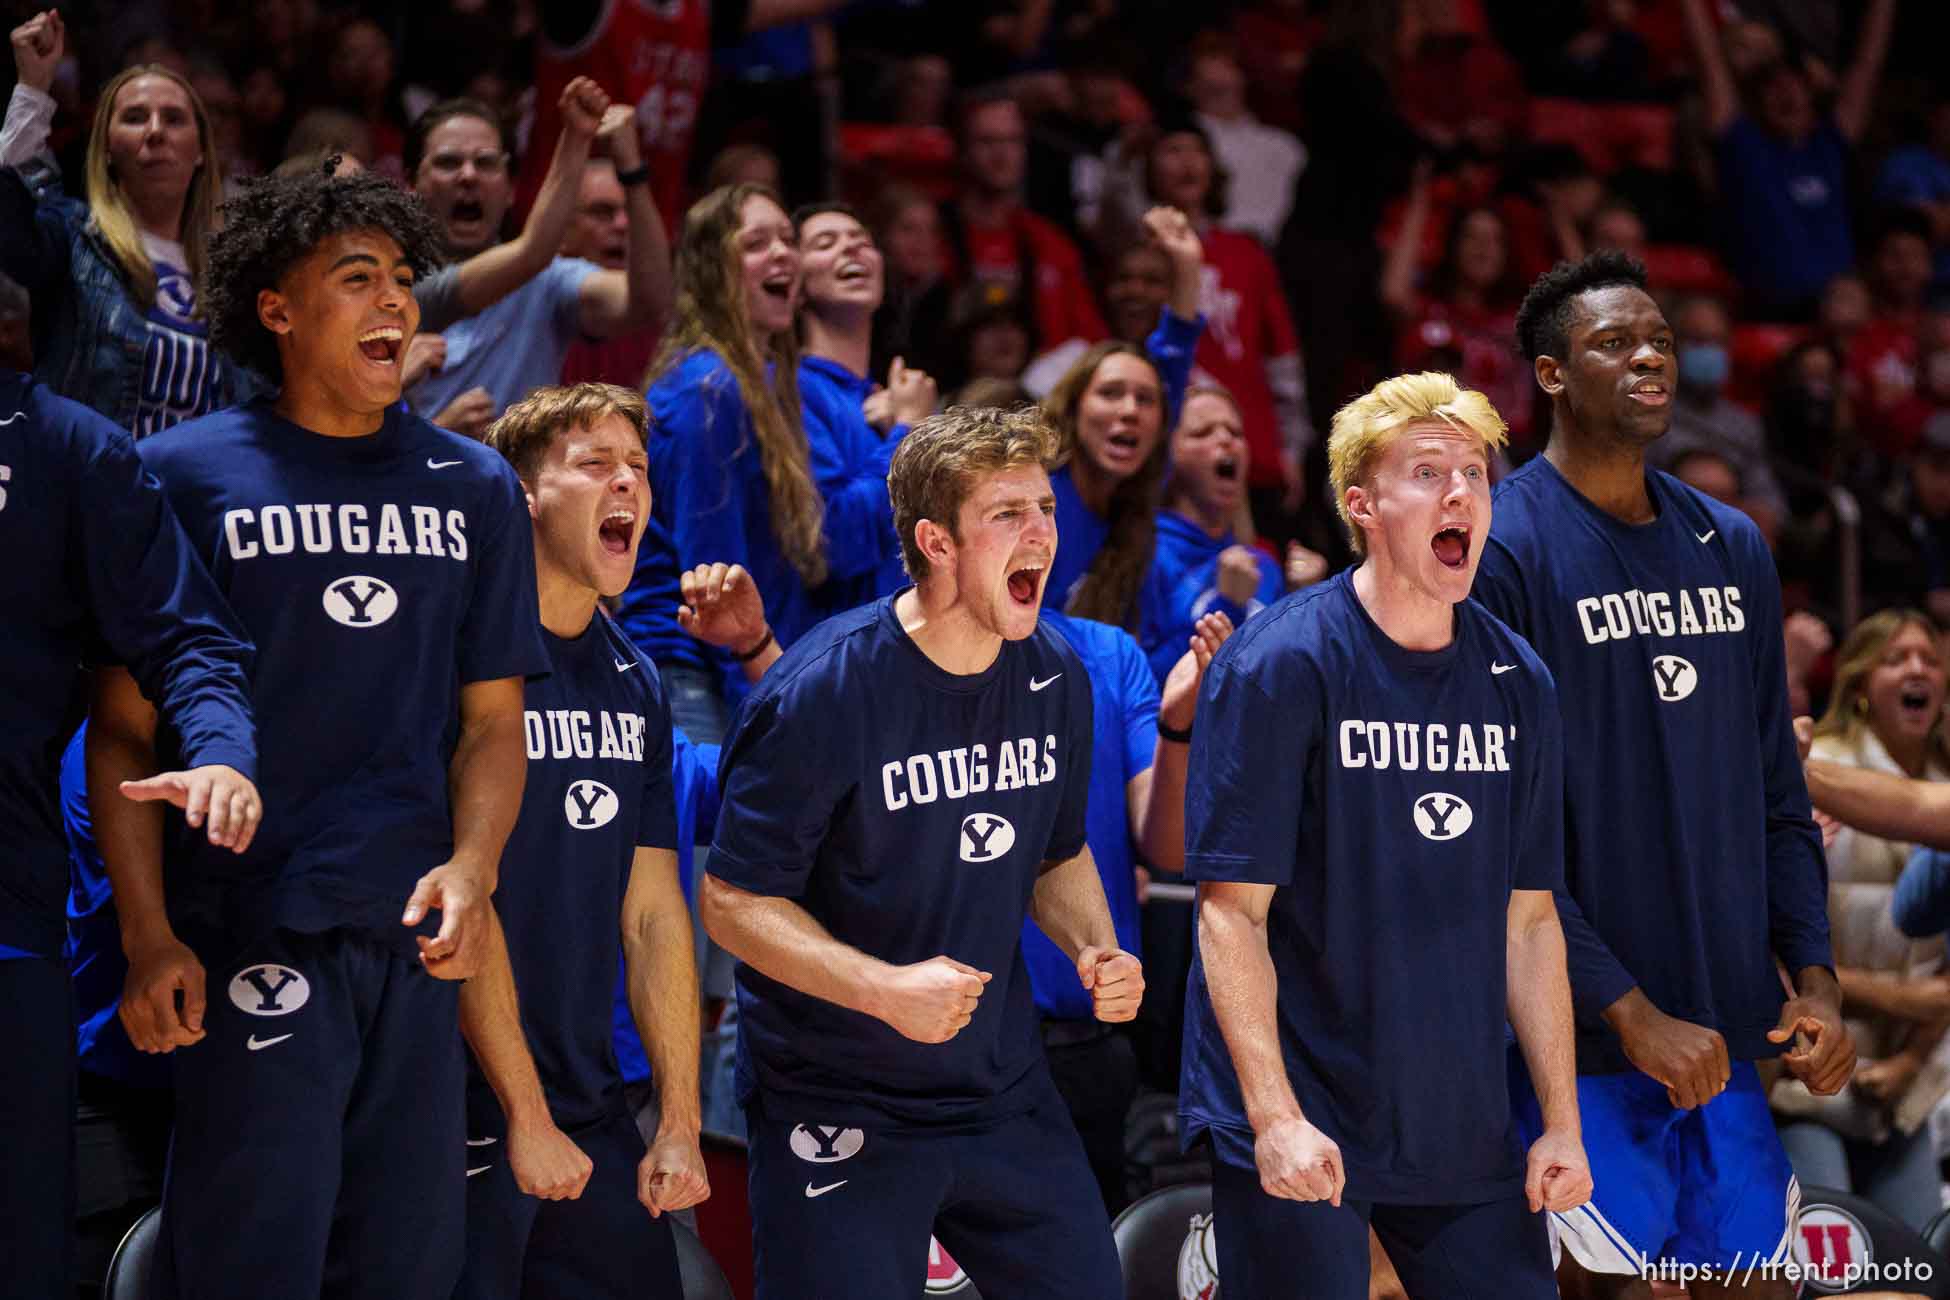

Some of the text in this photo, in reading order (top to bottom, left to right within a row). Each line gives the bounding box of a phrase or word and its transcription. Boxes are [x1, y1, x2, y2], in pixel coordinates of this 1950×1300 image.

[224, 504, 468, 561] COUGARS
[332, 580, 387, 623] Y
[1576, 586, 1745, 645] COUGARS
[1654, 660, 1688, 697] Y
[1339, 719, 1517, 772] COUGAR
[882, 735, 1056, 811] COUGARS
[569, 784, 609, 825] Y
[1417, 796, 1463, 836] Y
[962, 817, 1005, 858] Y
[240, 968, 299, 1011] Y
[799, 1123, 852, 1158] Y
